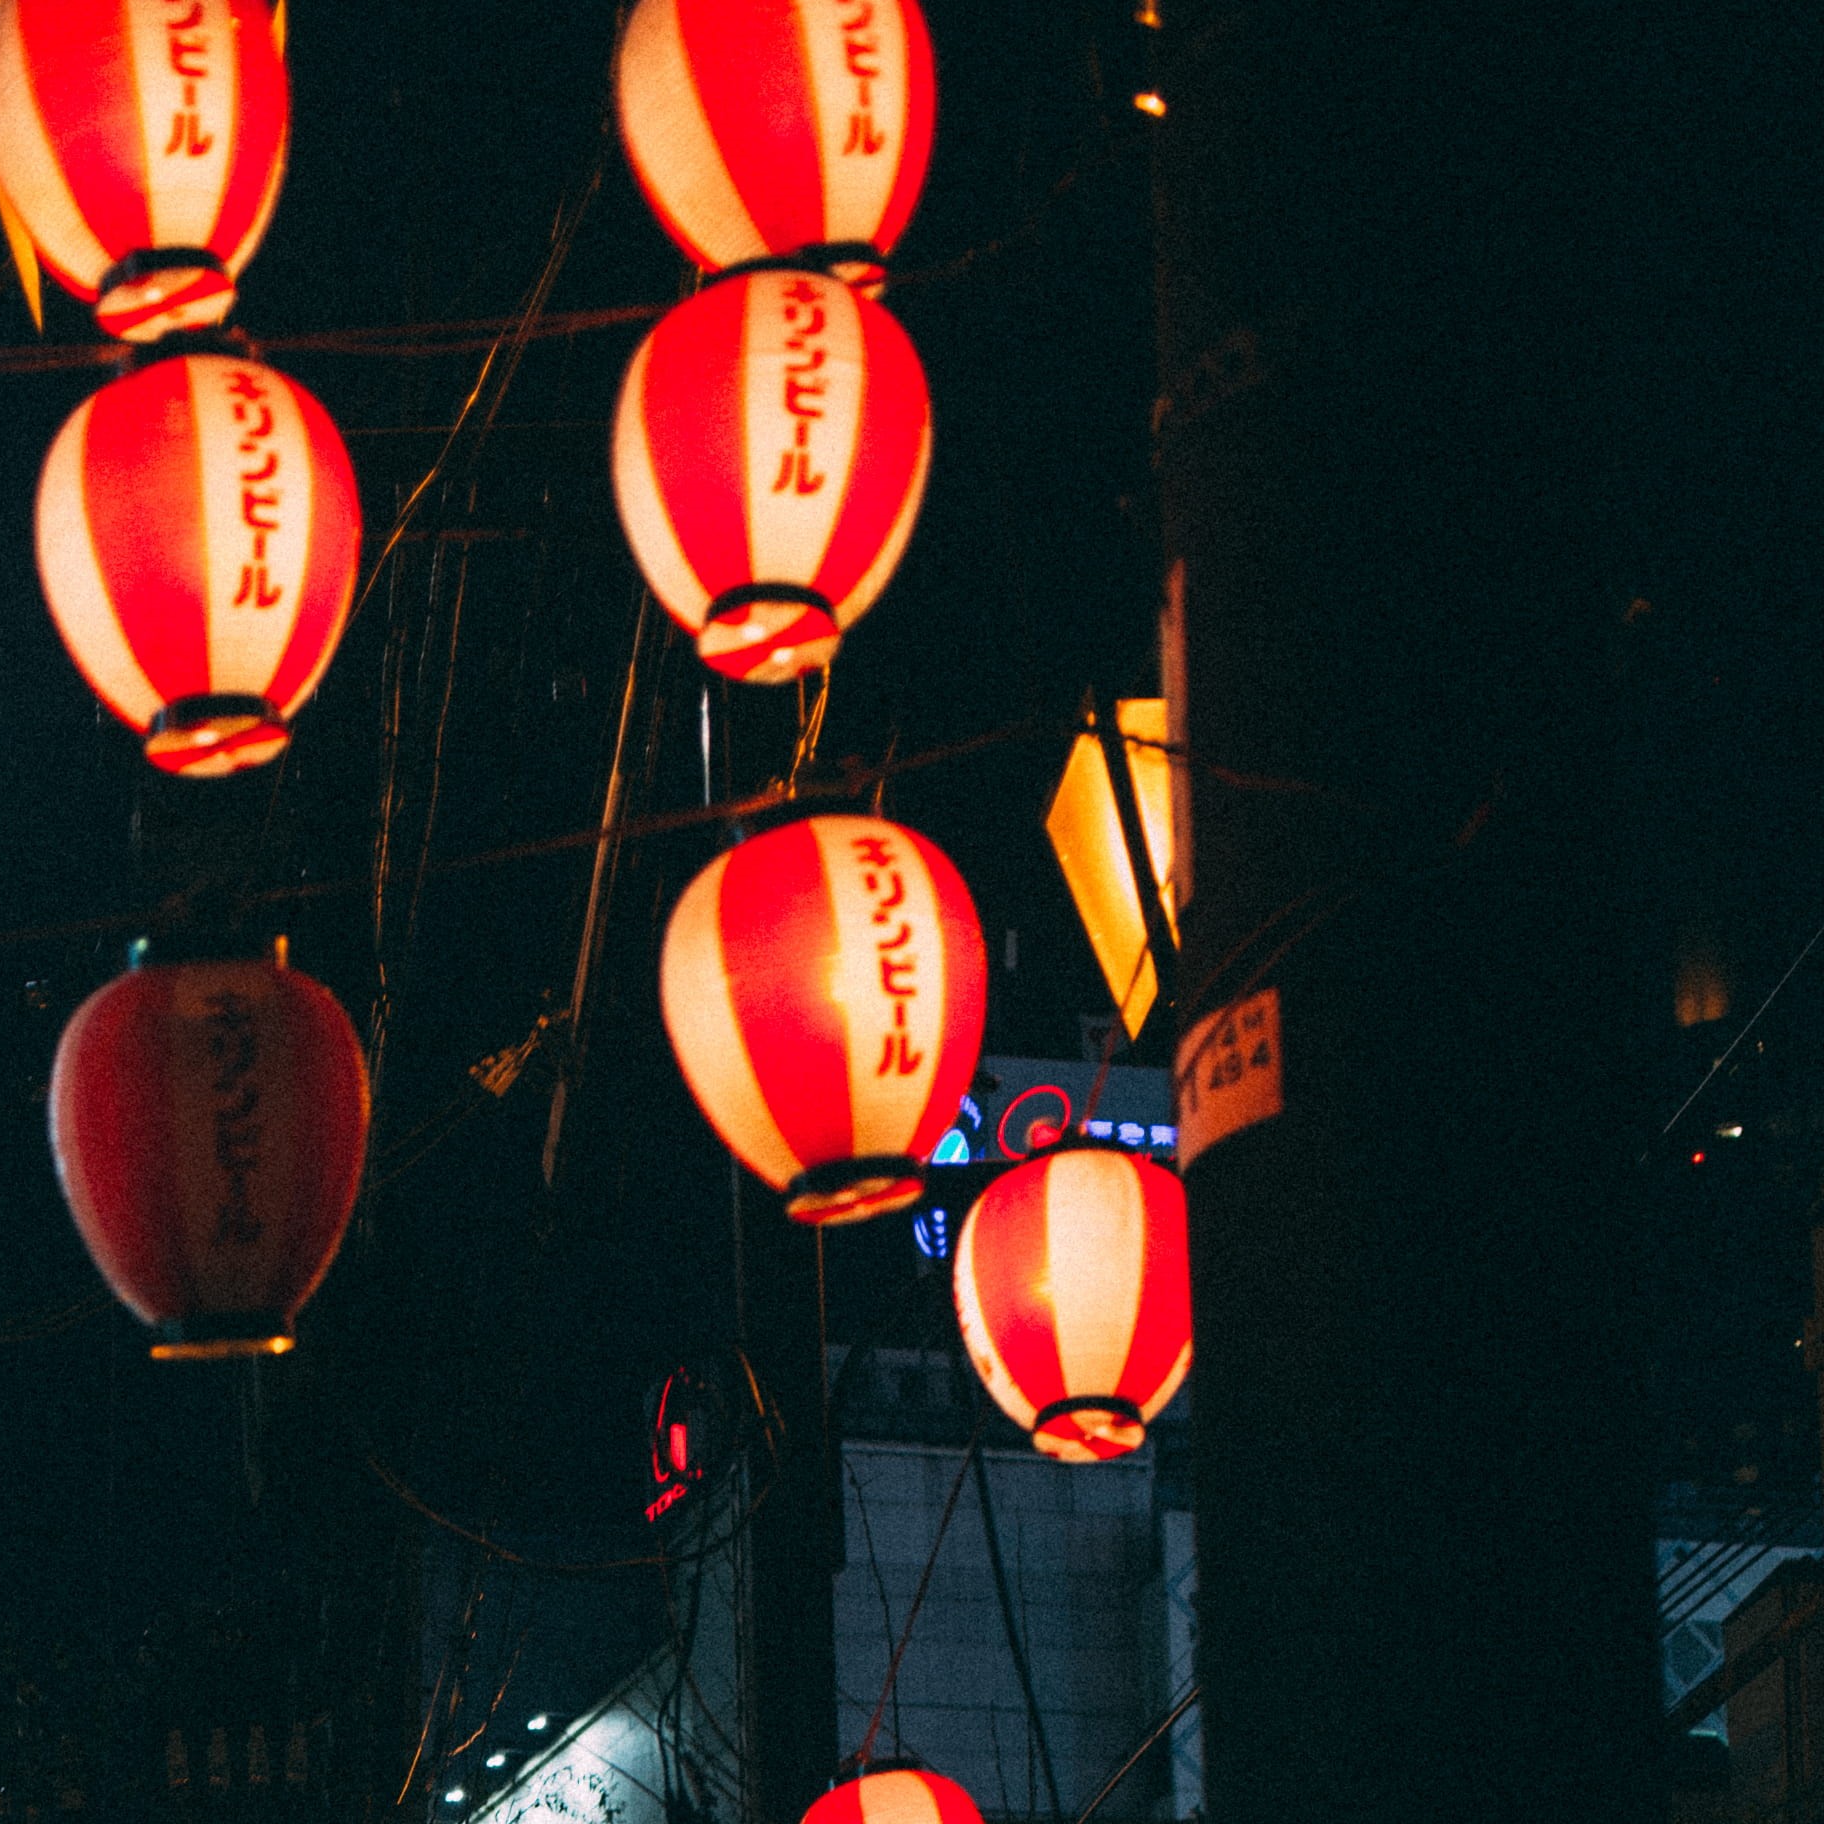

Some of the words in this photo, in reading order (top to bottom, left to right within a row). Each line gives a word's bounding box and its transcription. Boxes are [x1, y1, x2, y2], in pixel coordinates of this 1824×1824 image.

[223, 370, 284, 610] キリンビール
[771, 279, 828, 497] キリンビール
[851, 835, 924, 1077] キリンビール
